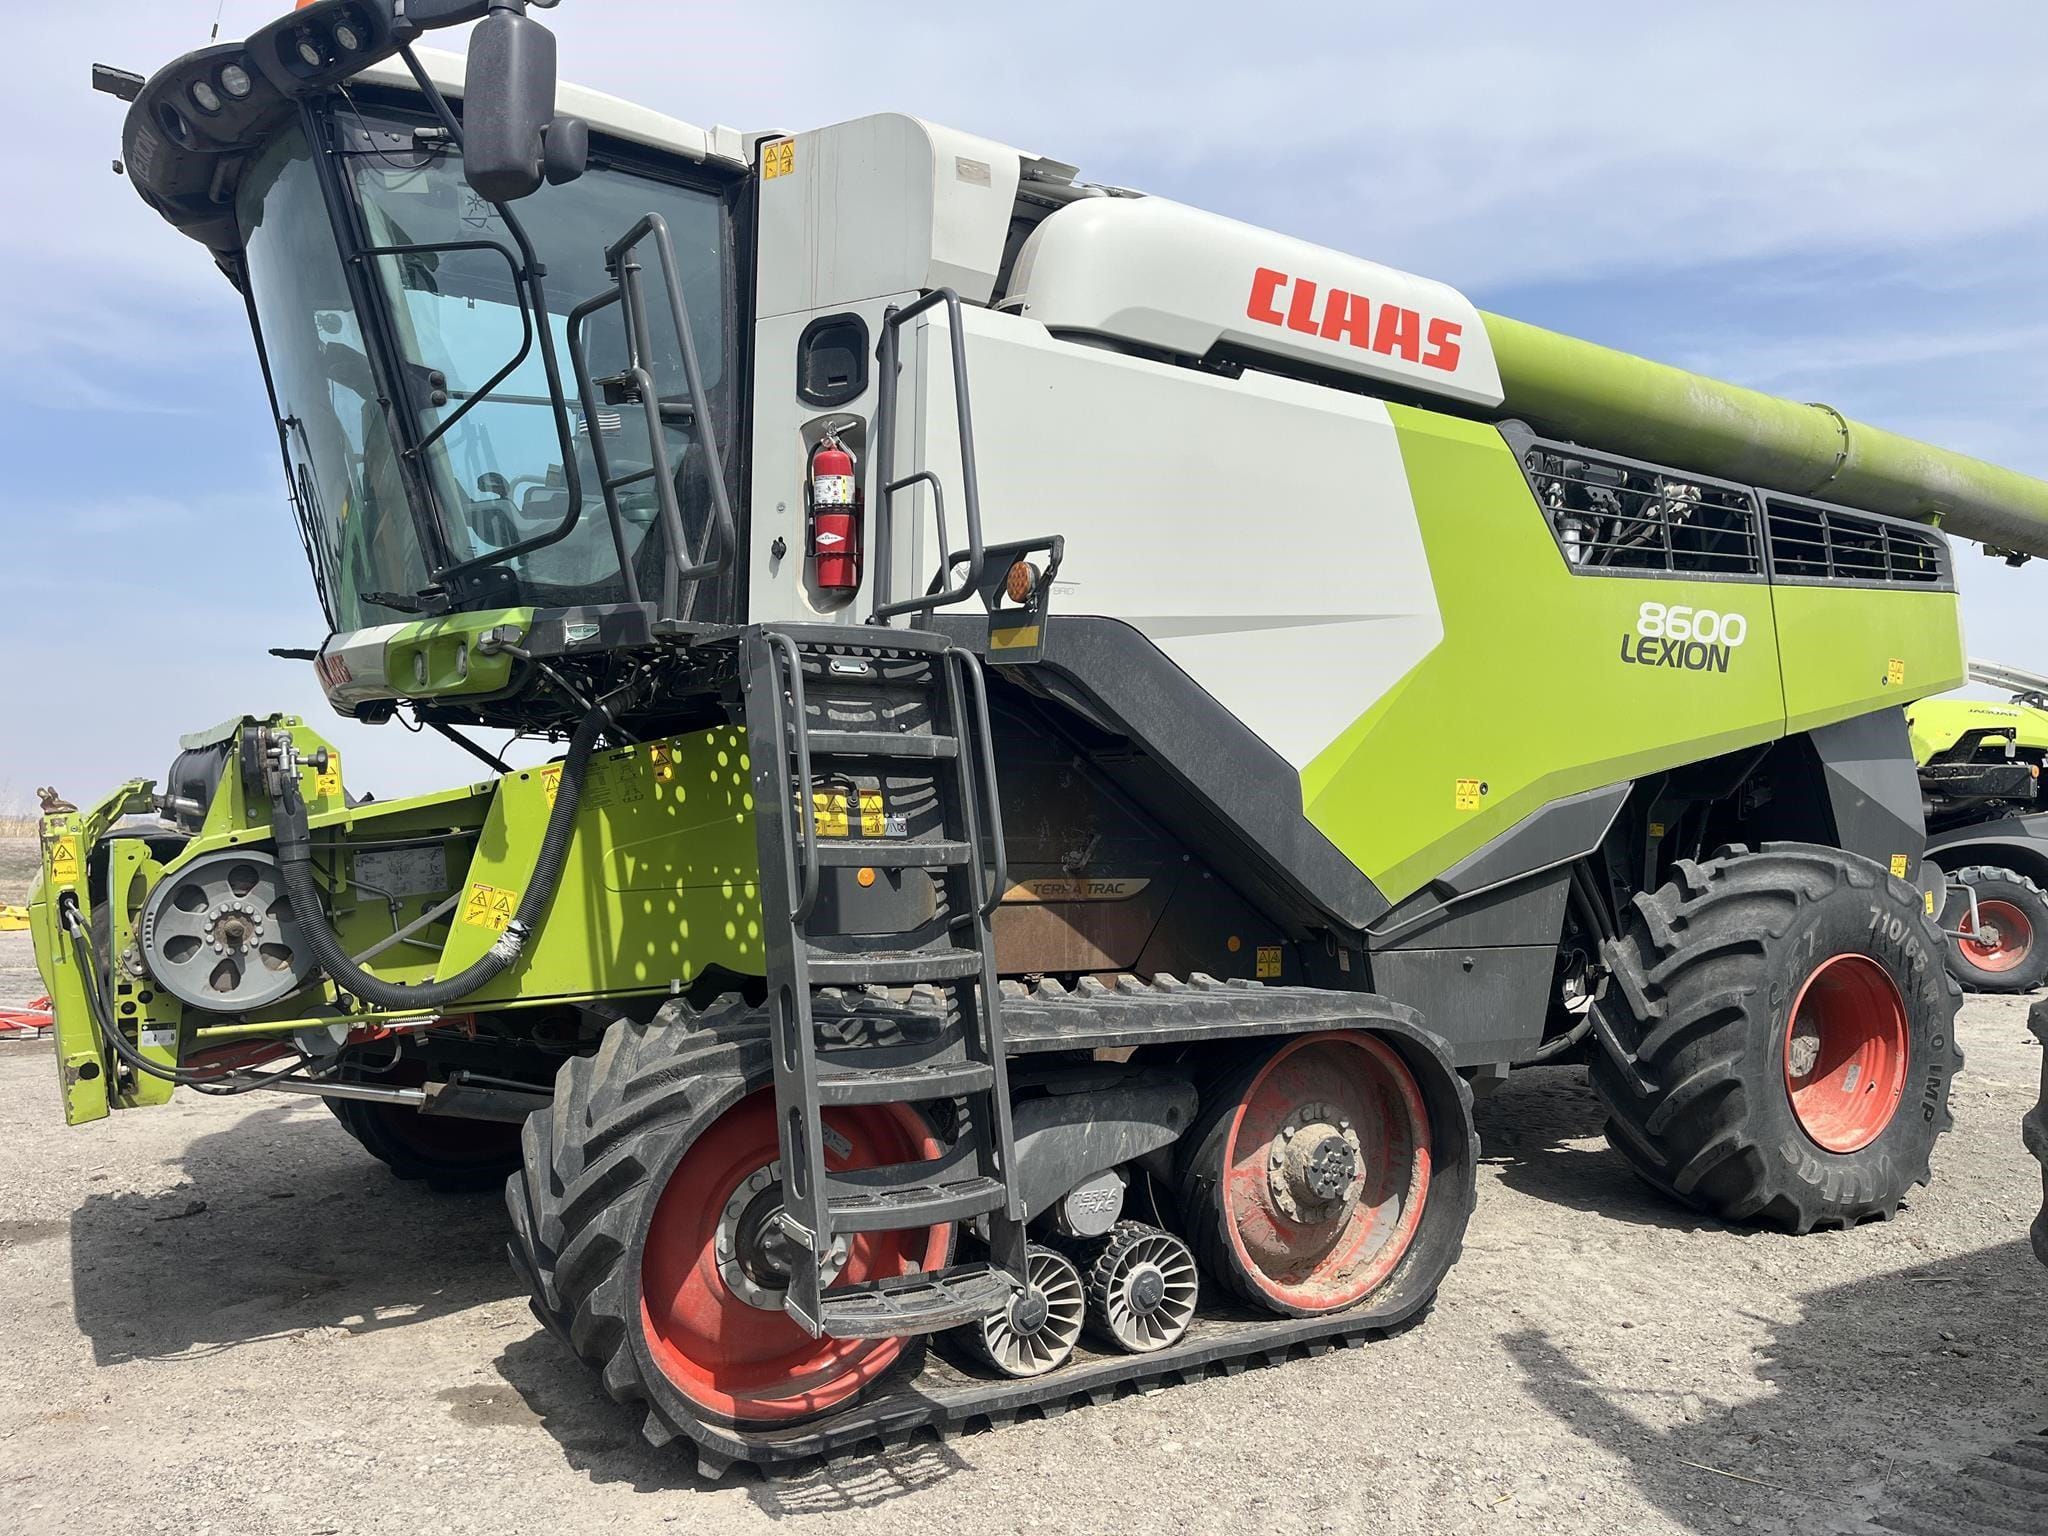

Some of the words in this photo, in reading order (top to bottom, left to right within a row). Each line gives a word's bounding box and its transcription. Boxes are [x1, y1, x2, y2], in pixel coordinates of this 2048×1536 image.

[1247, 267, 1462, 372] CLAAS
[1637, 602, 1747, 647] 8600
[1620, 634, 1730, 673] LEXION
[1033, 883, 1082, 895] TERRA
[1087, 883, 1125, 894] TRAC
[1073, 1188, 1118, 1204] TERRA
[1079, 1200, 1115, 1215] TRAC
